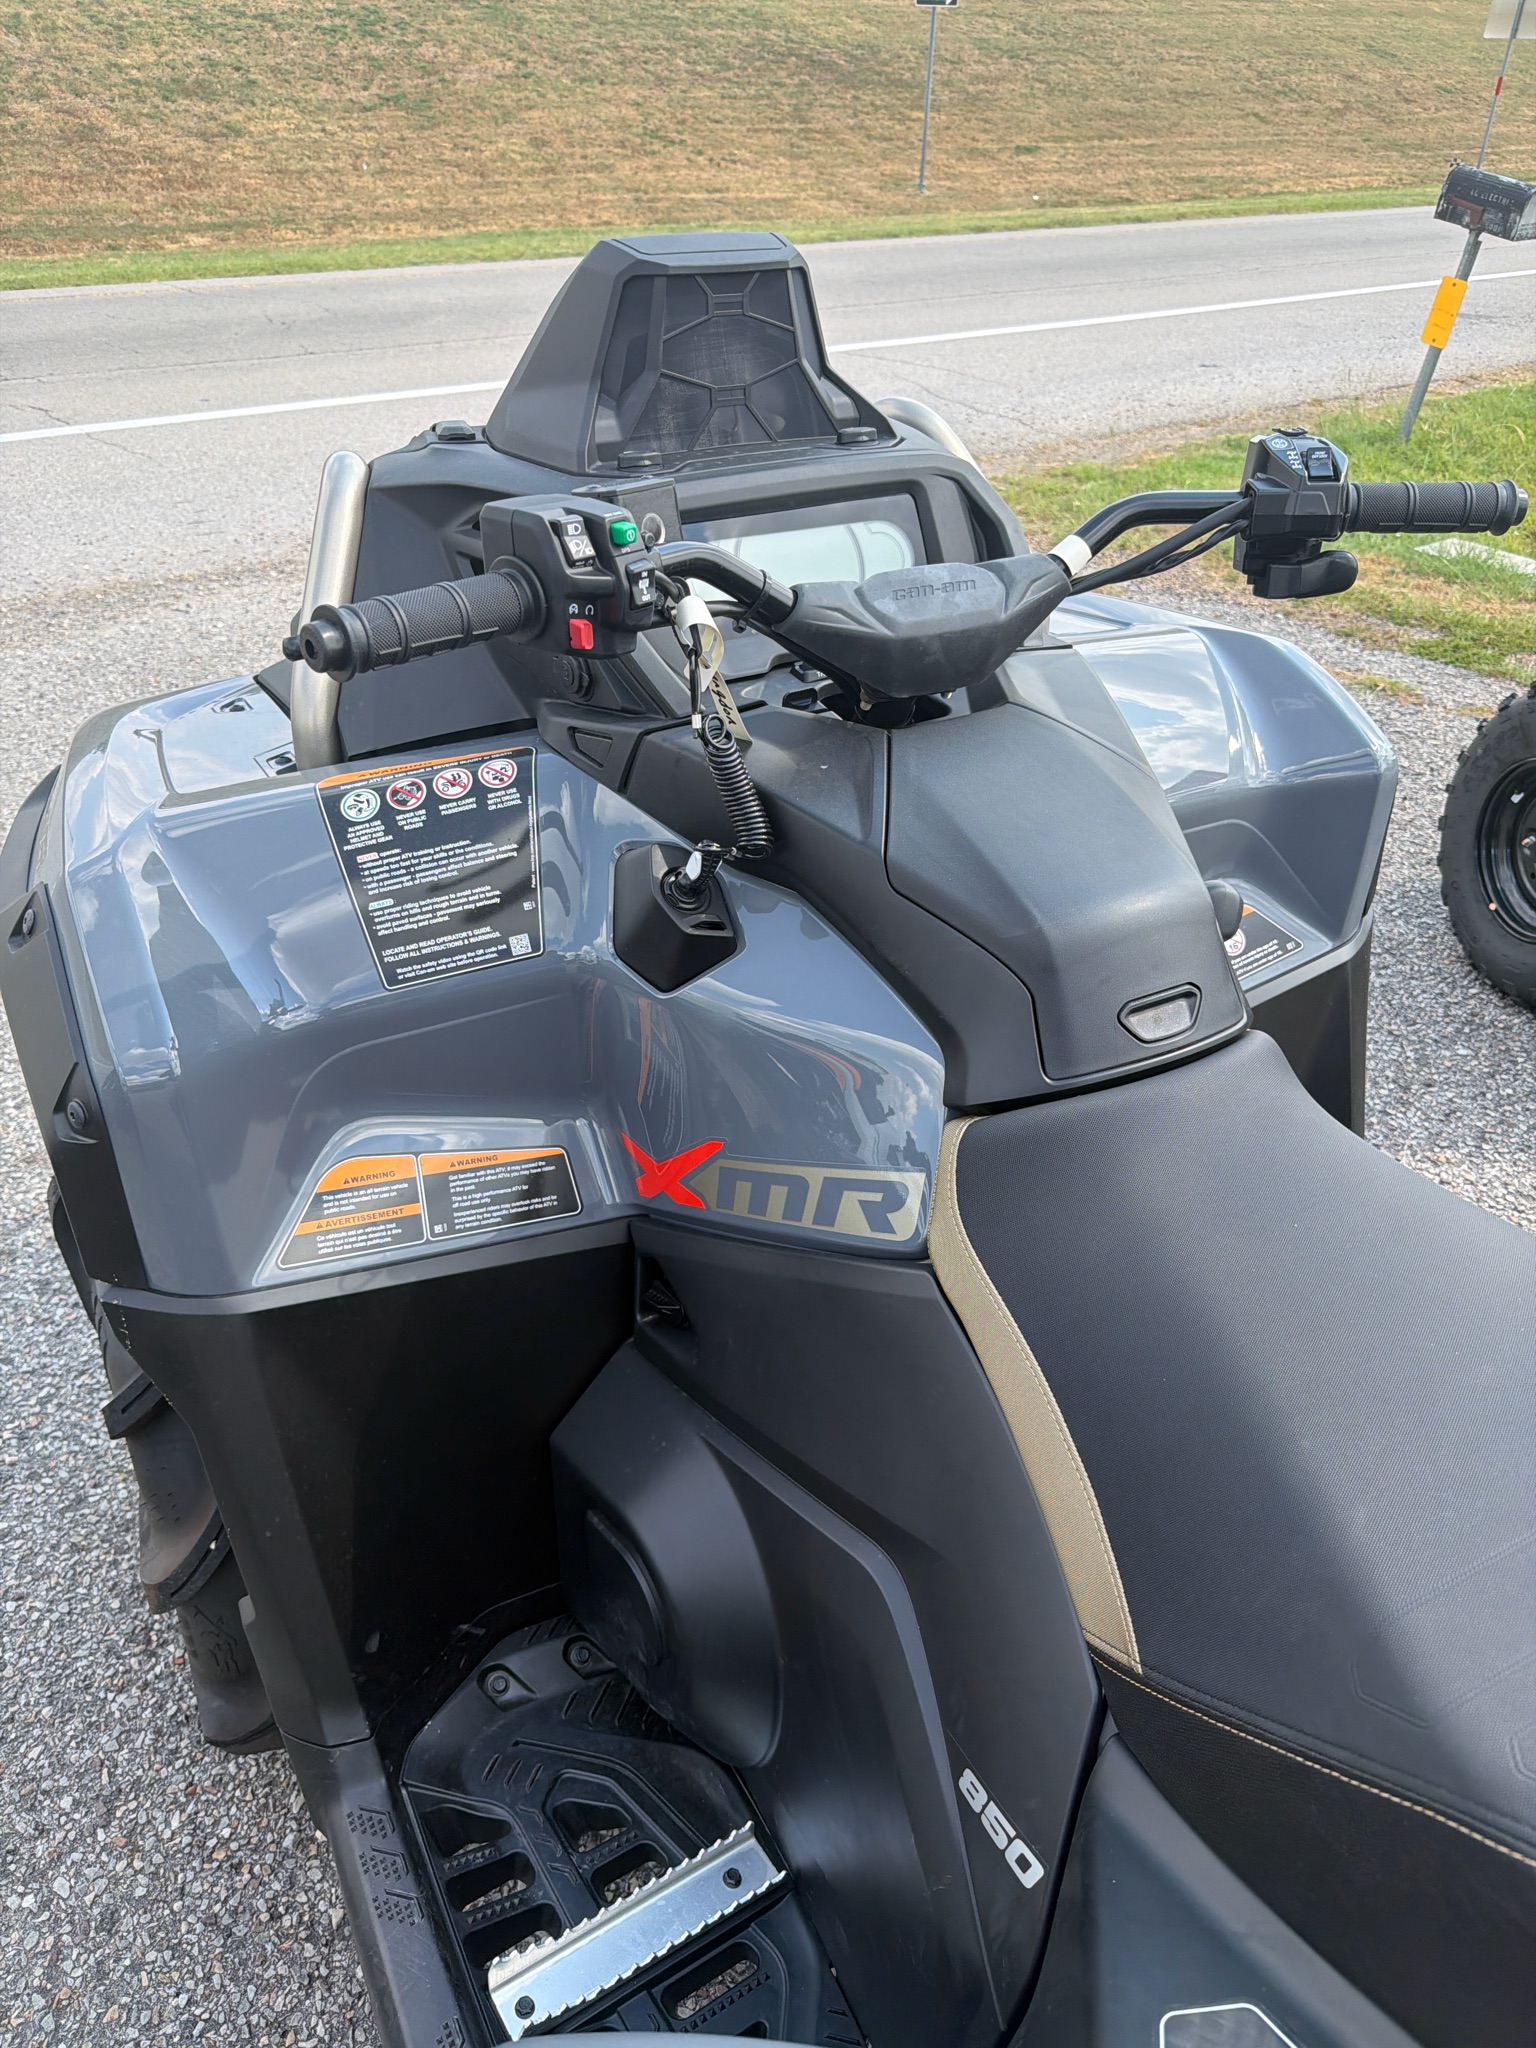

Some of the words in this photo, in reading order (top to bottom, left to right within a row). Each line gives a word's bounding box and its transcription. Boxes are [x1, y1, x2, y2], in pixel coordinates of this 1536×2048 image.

[487, 790, 506, 799] NEVER
[487, 797, 502, 805] WITH
[501, 792, 520, 801] DRUGS
[438, 802, 458, 810] NEVER
[458, 797, 477, 806] CARRY
[496, 799, 522, 809] ALCOHOL
[441, 803, 477, 816] PASSENGERS
[395, 812, 415, 820] NEVER
[407, 815, 427, 824] PUBLIC
[348, 823, 370, 833] ALWAYS
[355, 825, 385, 836] APPROVED
[403, 822, 424, 831] ROADS
[343, 839, 377, 851] PROTECTIVE
[377, 835, 393, 843] GEAR
[350, 835, 372, 844] HELMET
[357, 853, 377, 861] NEVER
[401, 852, 413, 860] ATV
[412, 848, 434, 857] training
[381, 946, 406, 956] LOCATE
[405, 943, 419, 951] AND
[419, 939, 436, 948] READ
[436, 930, 473, 944] OPERATOR'S
[384, 953, 409, 963] FOLLOW
[409, 949, 421, 958] ALL
[421, 940, 464, 955] INSTRUCTIONS
[469, 931, 502, 944] WARNINGS.
[1229, 942, 1239, 952] 16
[395, 965, 413, 974] Watch
[456, 1154, 498, 1167] WARNING
[350, 1170, 396, 1184] WARNING
[325, 1207, 405, 1228] AVERTISSEMENT
[959, 1768, 1044, 1889] 850
